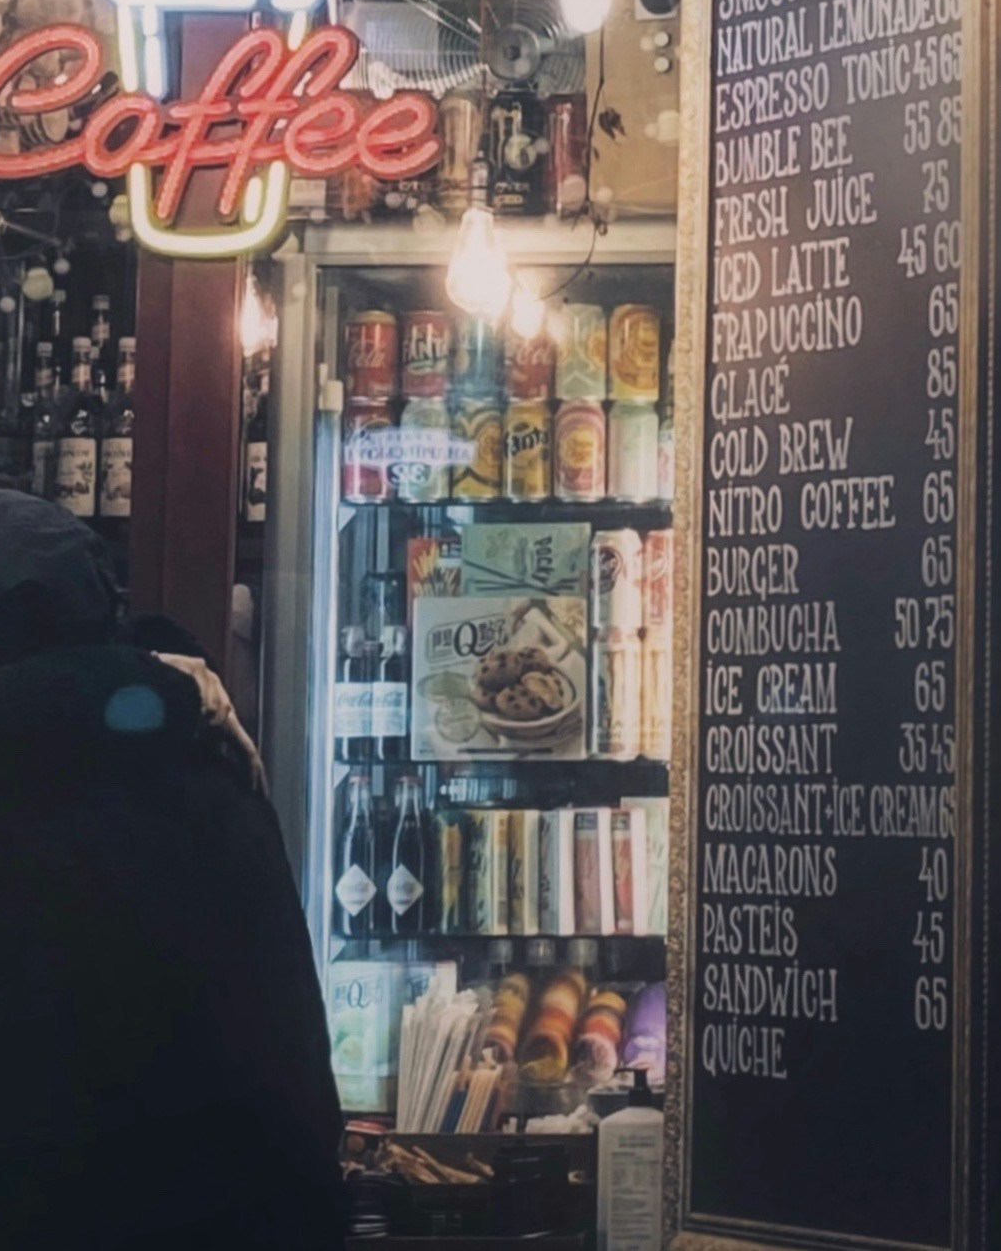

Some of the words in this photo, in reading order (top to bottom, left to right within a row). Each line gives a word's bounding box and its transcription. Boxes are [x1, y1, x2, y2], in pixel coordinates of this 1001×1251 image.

[717, 7, 813, 77] NATURAL
[716, 61, 829, 133] ESPRESSO
[715, 125, 800, 188] BUMBLE
[810, 116, 852, 171] BEE
[903, 101, 931, 154] 55
[714, 185, 789, 247] FRESH
[771, 237, 850, 297] LATTE
[898, 224, 926, 278] 45
[929, 283, 958, 338] 65
[926, 346, 956, 398] 85
[710, 425, 768, 480] COLD
[778, 416, 853, 475] BREW
[925, 408, 954, 460] 45
[800, 475, 896, 530] COFFEE
[922, 471, 954, 524] 65
[707, 543, 799, 601] BURGER
[922, 535, 952, 587] 65
[707, 600, 841, 655] COMBUCHA
[895, 598, 919, 648] 50
[756, 662, 837, 714] CREAM
[914, 660, 945, 713] 65
[900, 723, 926, 773] 35
[870, 784, 938, 838] CREAM
[702, 842, 837, 897] MACARONS
[918, 847, 948, 902] 40
[913, 911, 944, 964] 45
[915, 976, 947, 1030] 65
